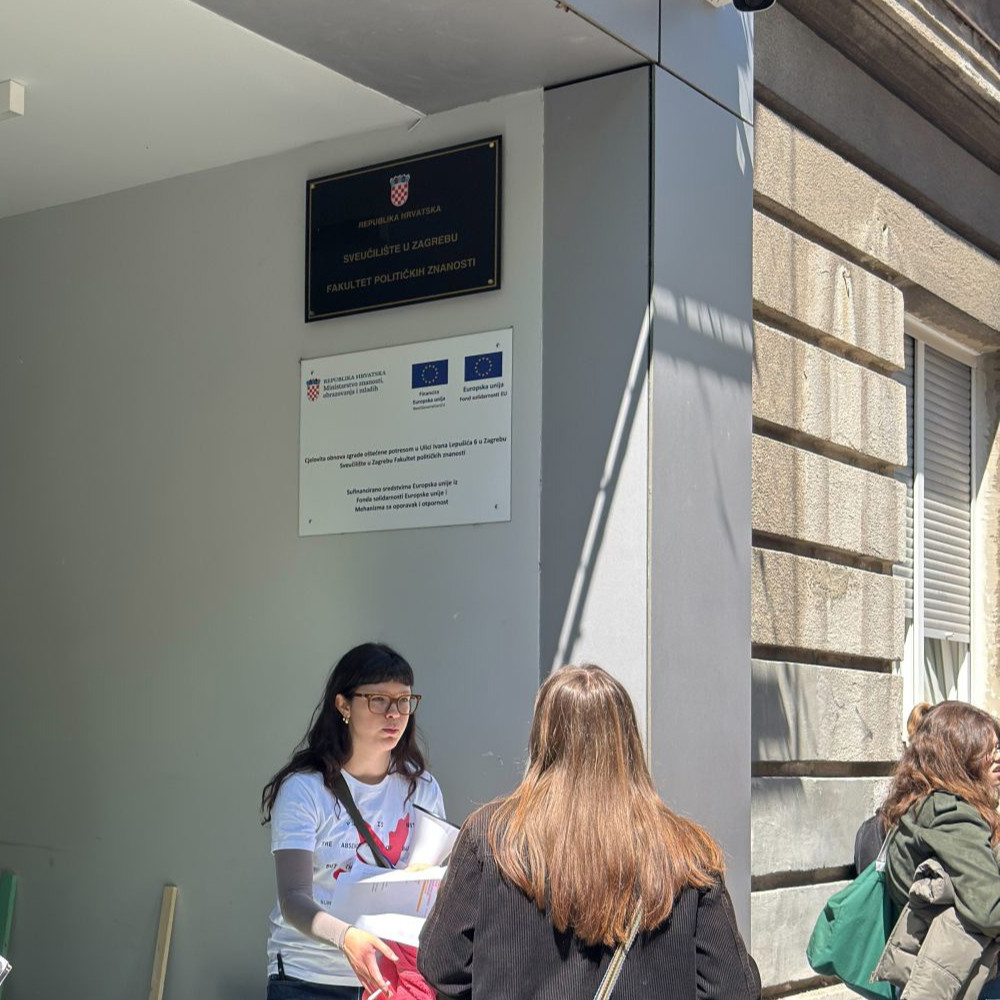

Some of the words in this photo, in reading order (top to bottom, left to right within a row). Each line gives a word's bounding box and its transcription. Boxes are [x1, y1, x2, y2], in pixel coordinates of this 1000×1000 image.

[358, 213, 399, 229] REPUBLIKA
[401, 205, 441, 220] HRVATSKA
[343, 243, 401, 264] SVEUČILIŠTE
[403, 242, 410, 252] U
[411, 232, 459, 251] ZAGREBU
[326, 277, 372, 294] FAKULTET
[427, 257, 476, 275] ZNANOSTI
[323, 375, 355, 384] REPUBLIKA
[355, 370, 386, 380] HRVATSKA
[323, 381, 358, 392] Ministarstvo
[323, 389, 355, 399] obrazovanja
[359, 386, 379, 394] mladih
[463, 383, 489, 393] Europska
[490, 382, 504, 391] unija
[472, 392, 500, 400] solidarnosti
[304, 455, 326, 464] Cjelovita
[327, 454, 346, 462] obnova
[388, 447, 414, 456] potresom
[484, 436, 507, 445] Zagrebu
[372, 458, 393, 466] Zagrebu
[394, 455, 416, 464] Fakultet
[442, 450, 466, 459] znanosti
[346, 486, 382, 496] Sufinancirano
[382, 484, 412, 492] sredstvima
[438, 480, 452, 488] unije
[356, 496, 372, 504] Fonda
[373, 493, 404, 502] solidarnosti
[430, 490, 444, 499] unije
[354, 504, 385, 512] Mehanizma
[392, 502, 418, 510] oporavak
[422, 499, 449, 508] otpornost
